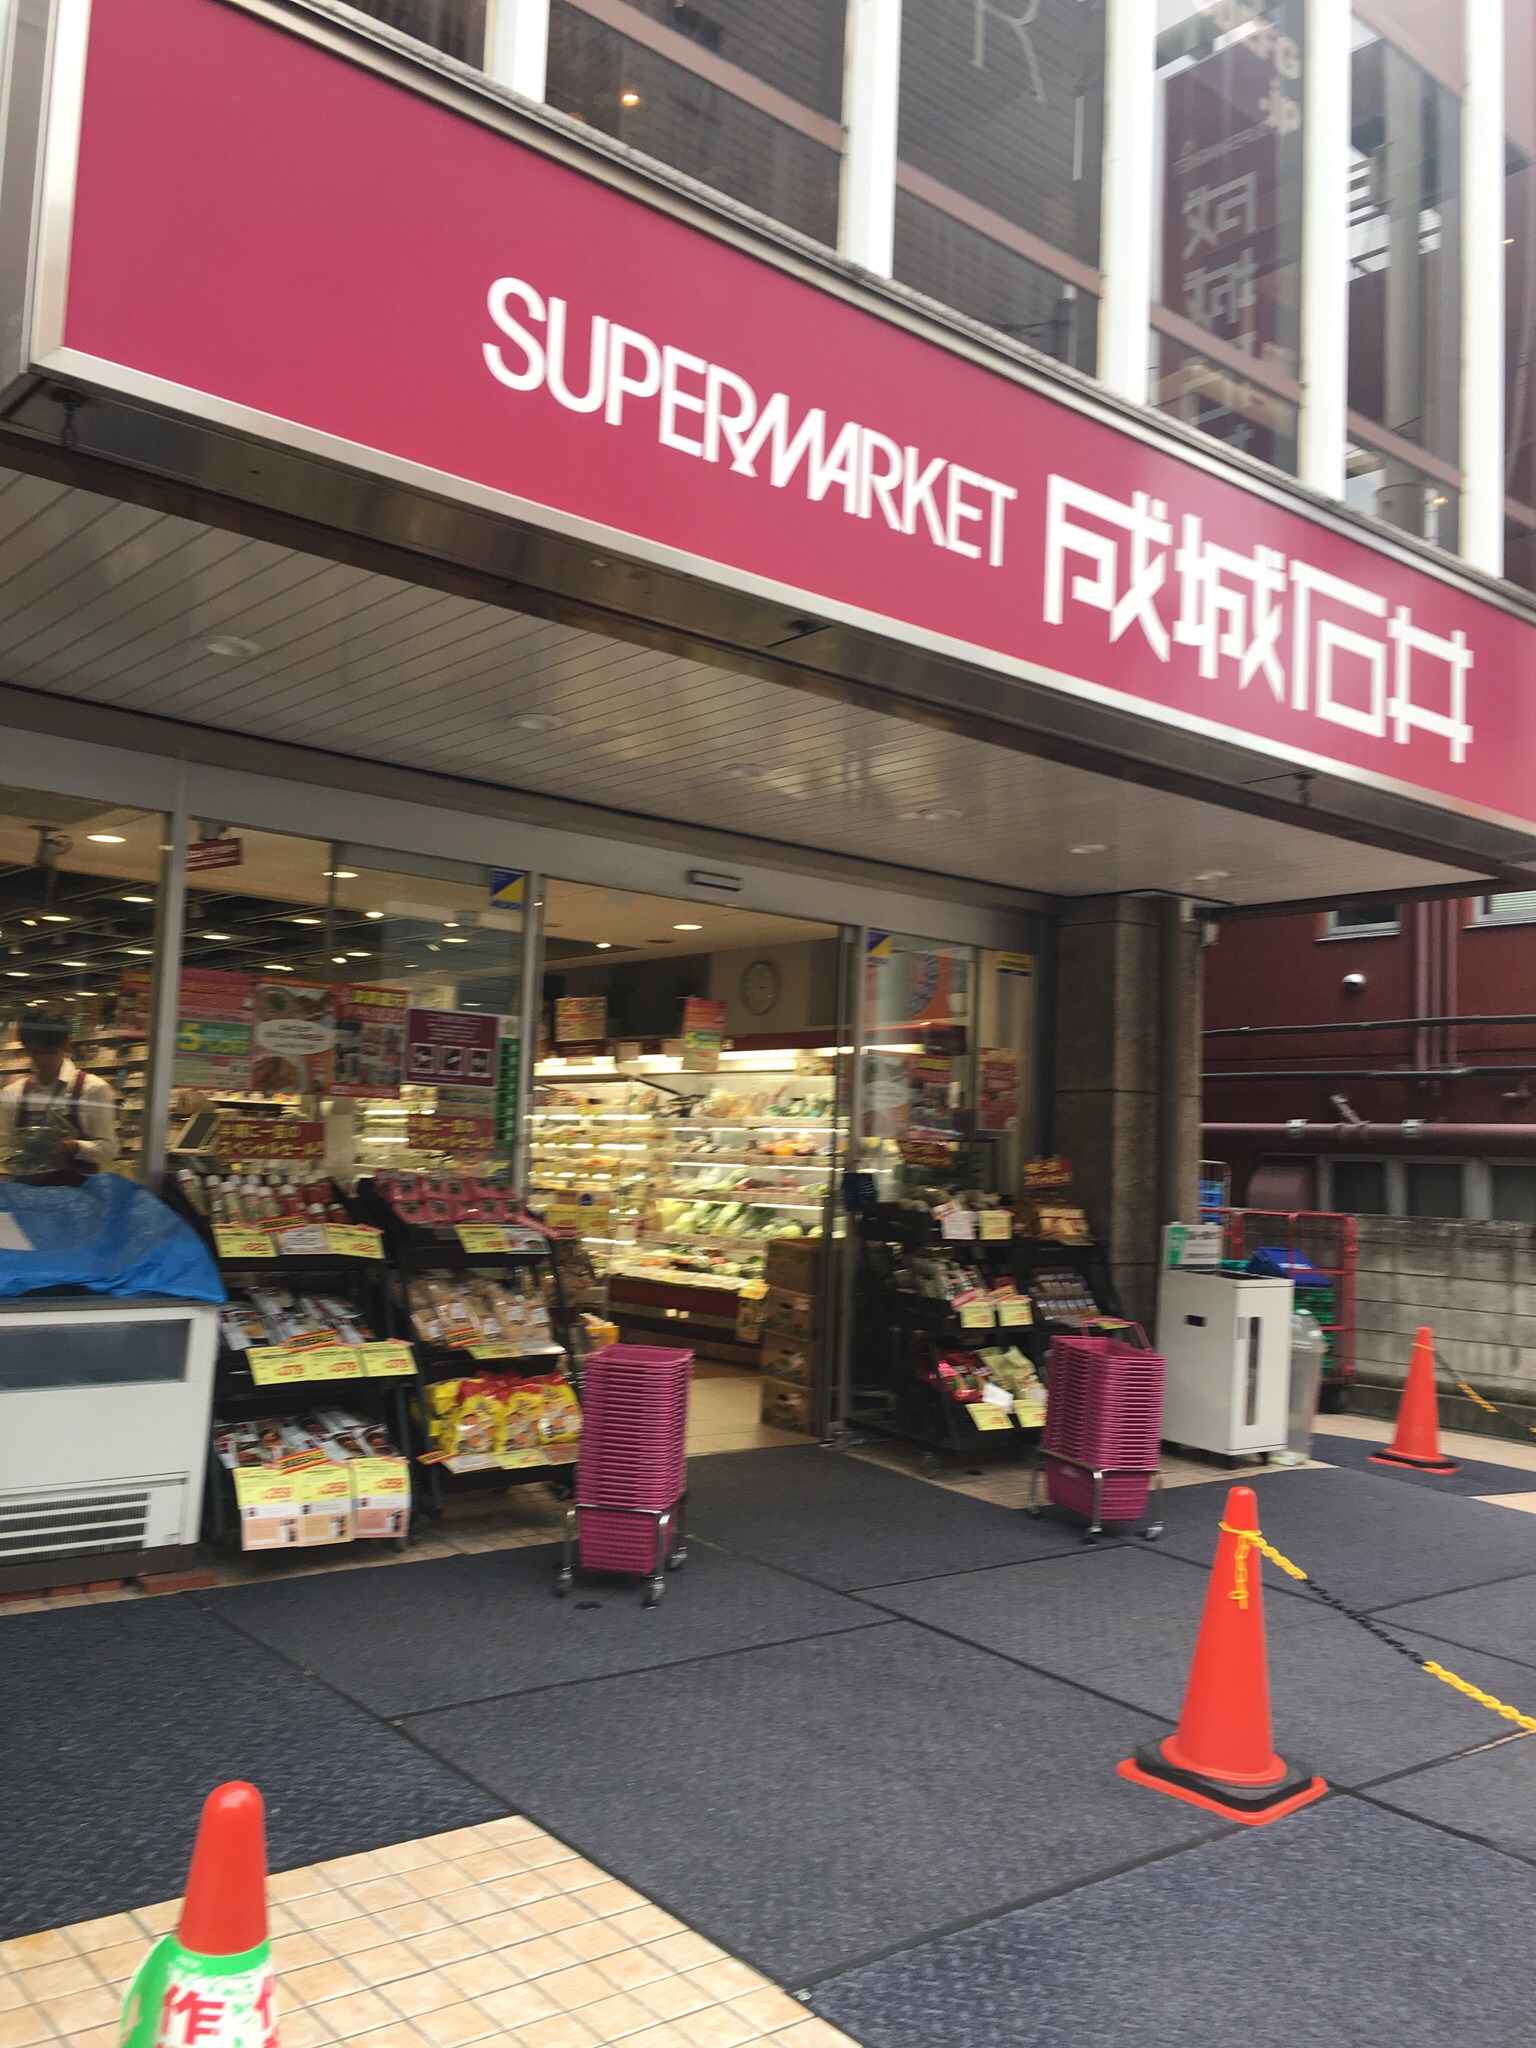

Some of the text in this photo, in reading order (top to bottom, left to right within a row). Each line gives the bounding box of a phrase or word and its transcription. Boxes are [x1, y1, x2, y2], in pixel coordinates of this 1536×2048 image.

[482, 276, 1018, 568] SUPERMARKET
[1044, 473, 1475, 764] 成城石井
